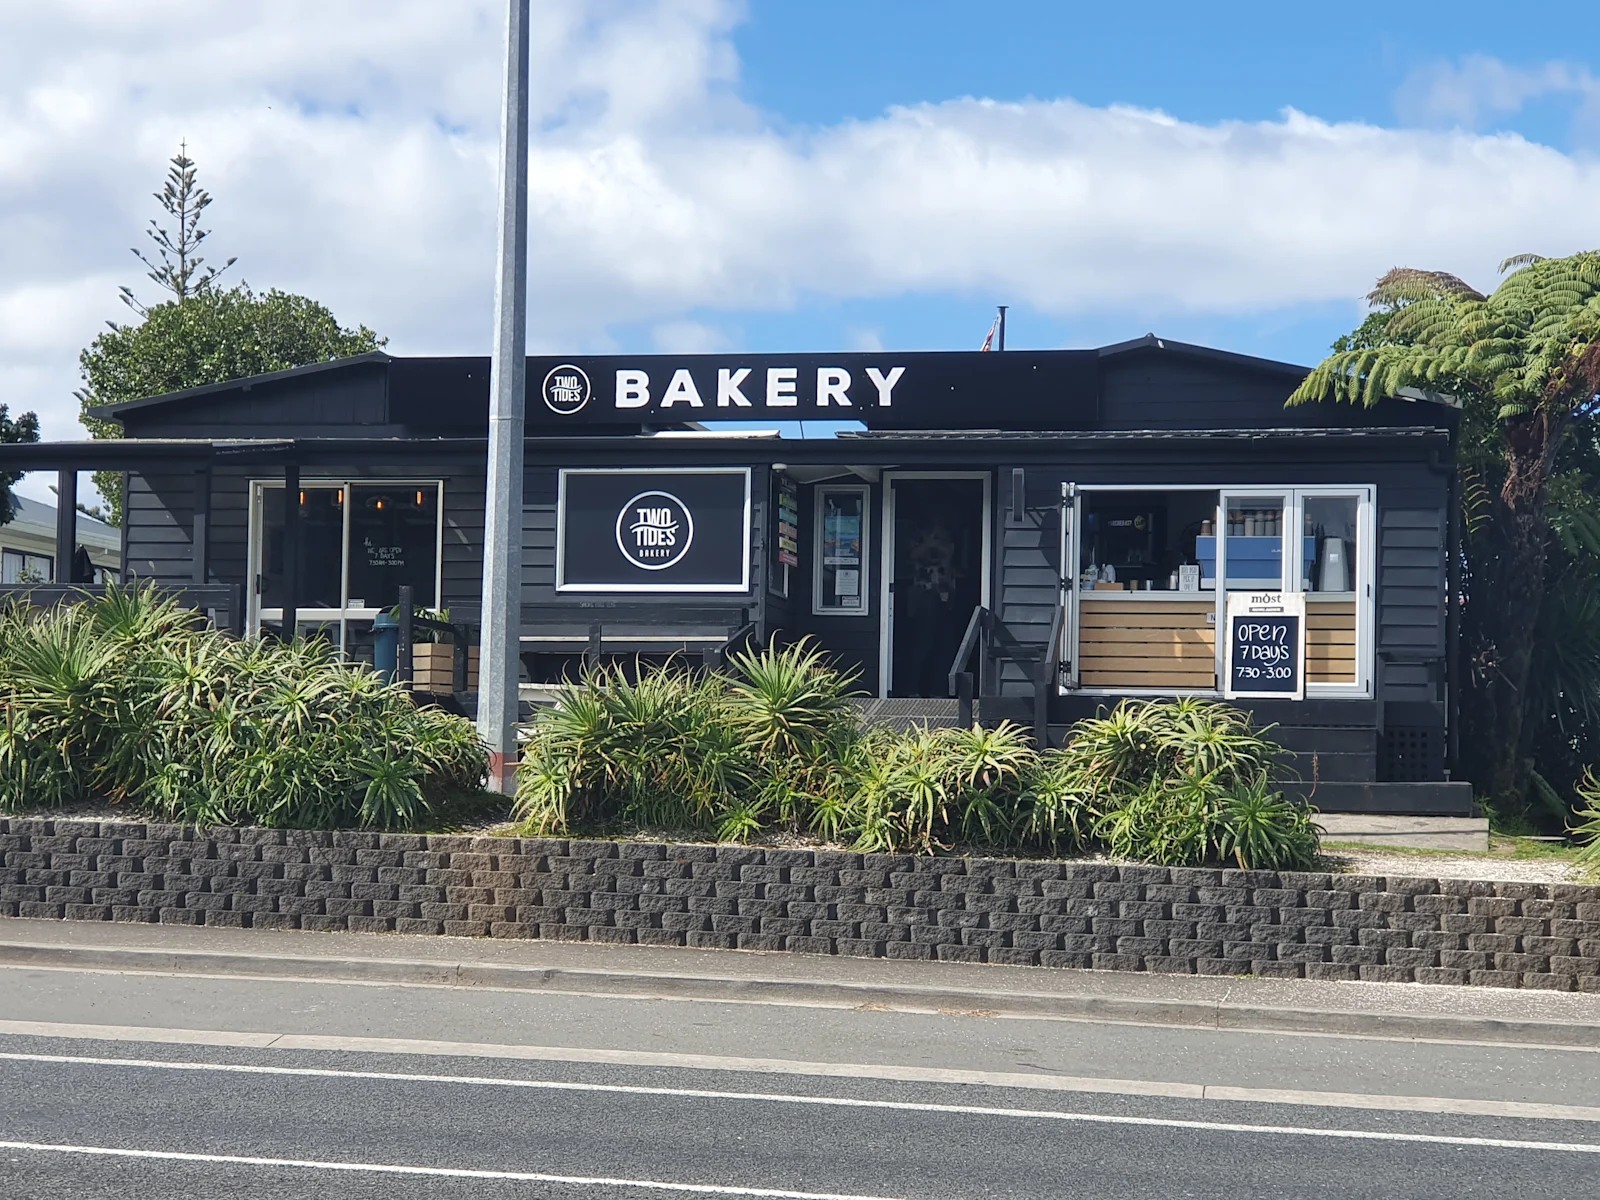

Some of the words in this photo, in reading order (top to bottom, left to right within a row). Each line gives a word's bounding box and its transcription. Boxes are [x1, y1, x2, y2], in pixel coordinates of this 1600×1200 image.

[554, 376, 578, 388] TWO
[615, 367, 906, 408] BAKERY
[553, 388, 581, 402] TIDES
[636, 508, 671, 526] TWO
[636, 526, 676, 546] TIDES
[639, 549, 670, 558] BAKERY
[1240, 645, 1249, 660] 7
